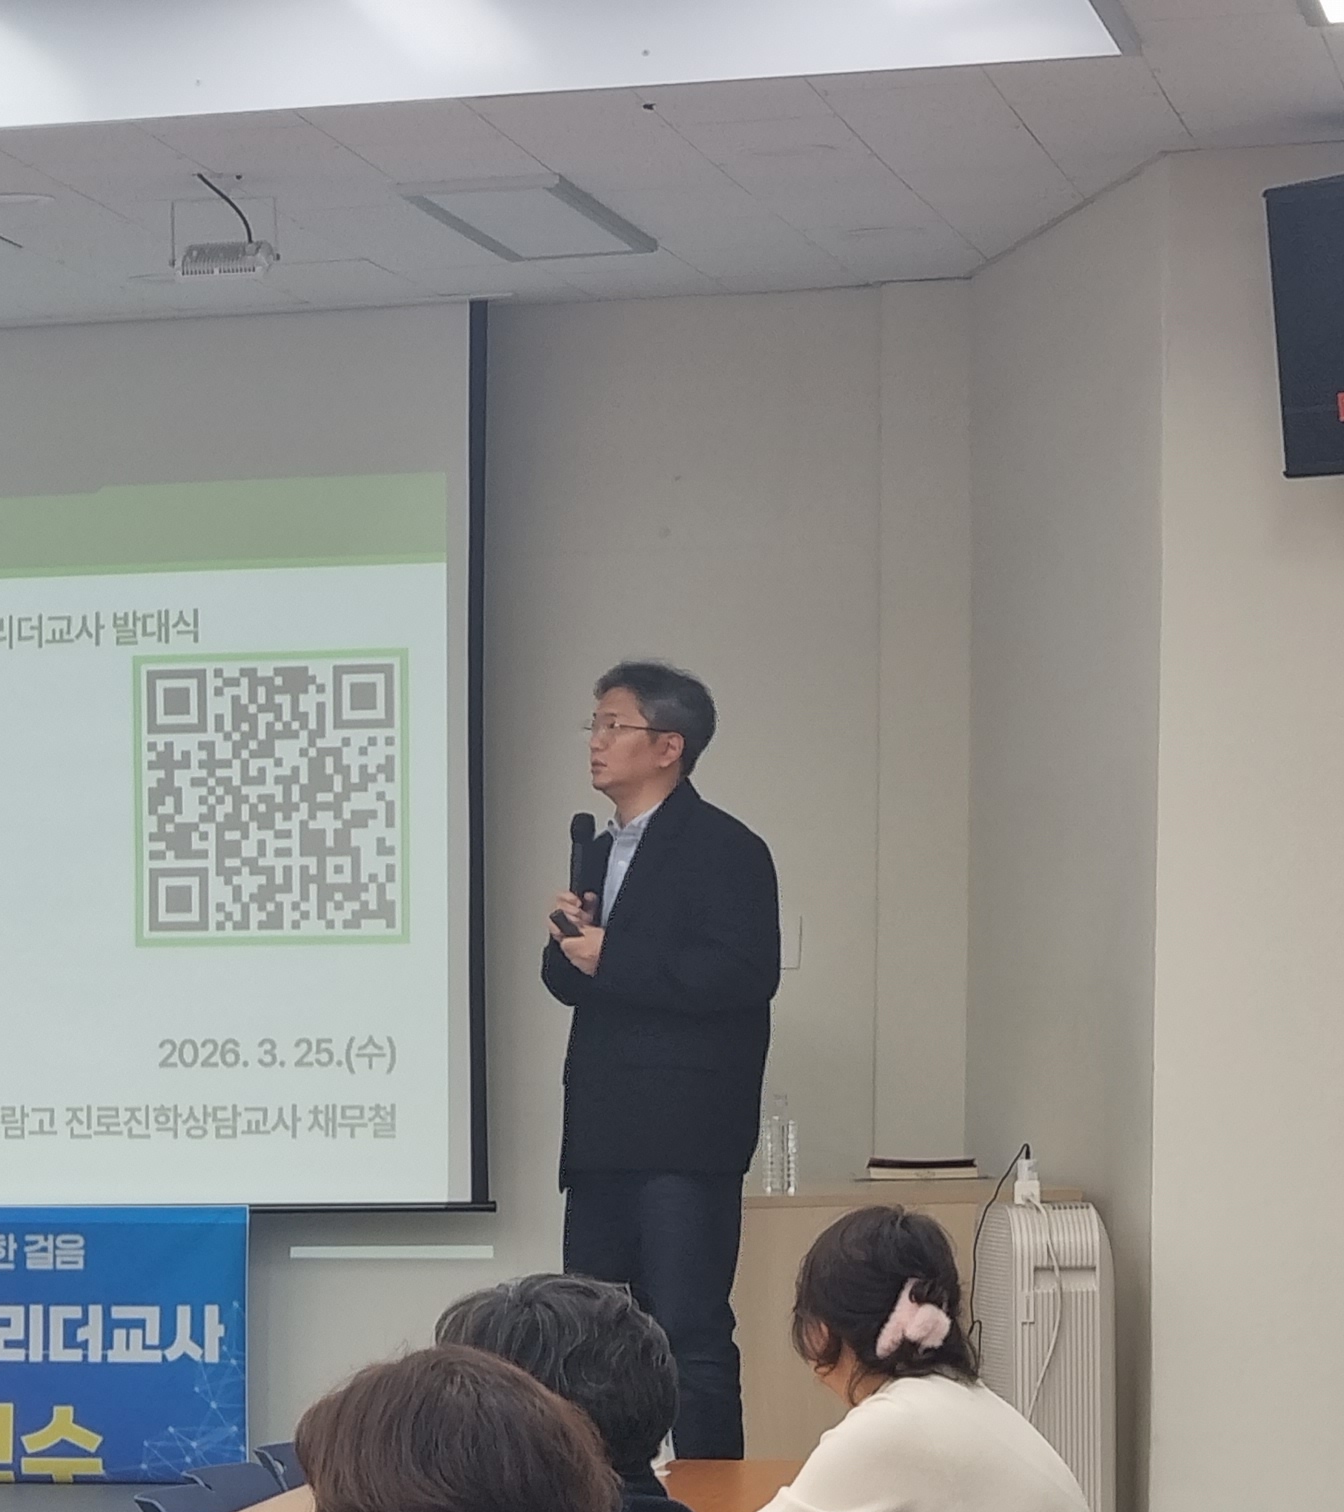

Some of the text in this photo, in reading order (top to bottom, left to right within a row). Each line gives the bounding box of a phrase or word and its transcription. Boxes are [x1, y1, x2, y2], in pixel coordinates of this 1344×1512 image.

[111, 607, 200, 647] 발대식
[157, 1034, 398, 1075] 2026. 3. 25.(수)
[65, 1102, 302, 1140] 진로진학상담교사
[307, 1102, 398, 1140] 채무철
[24, 1233, 86, 1271] 걸음
